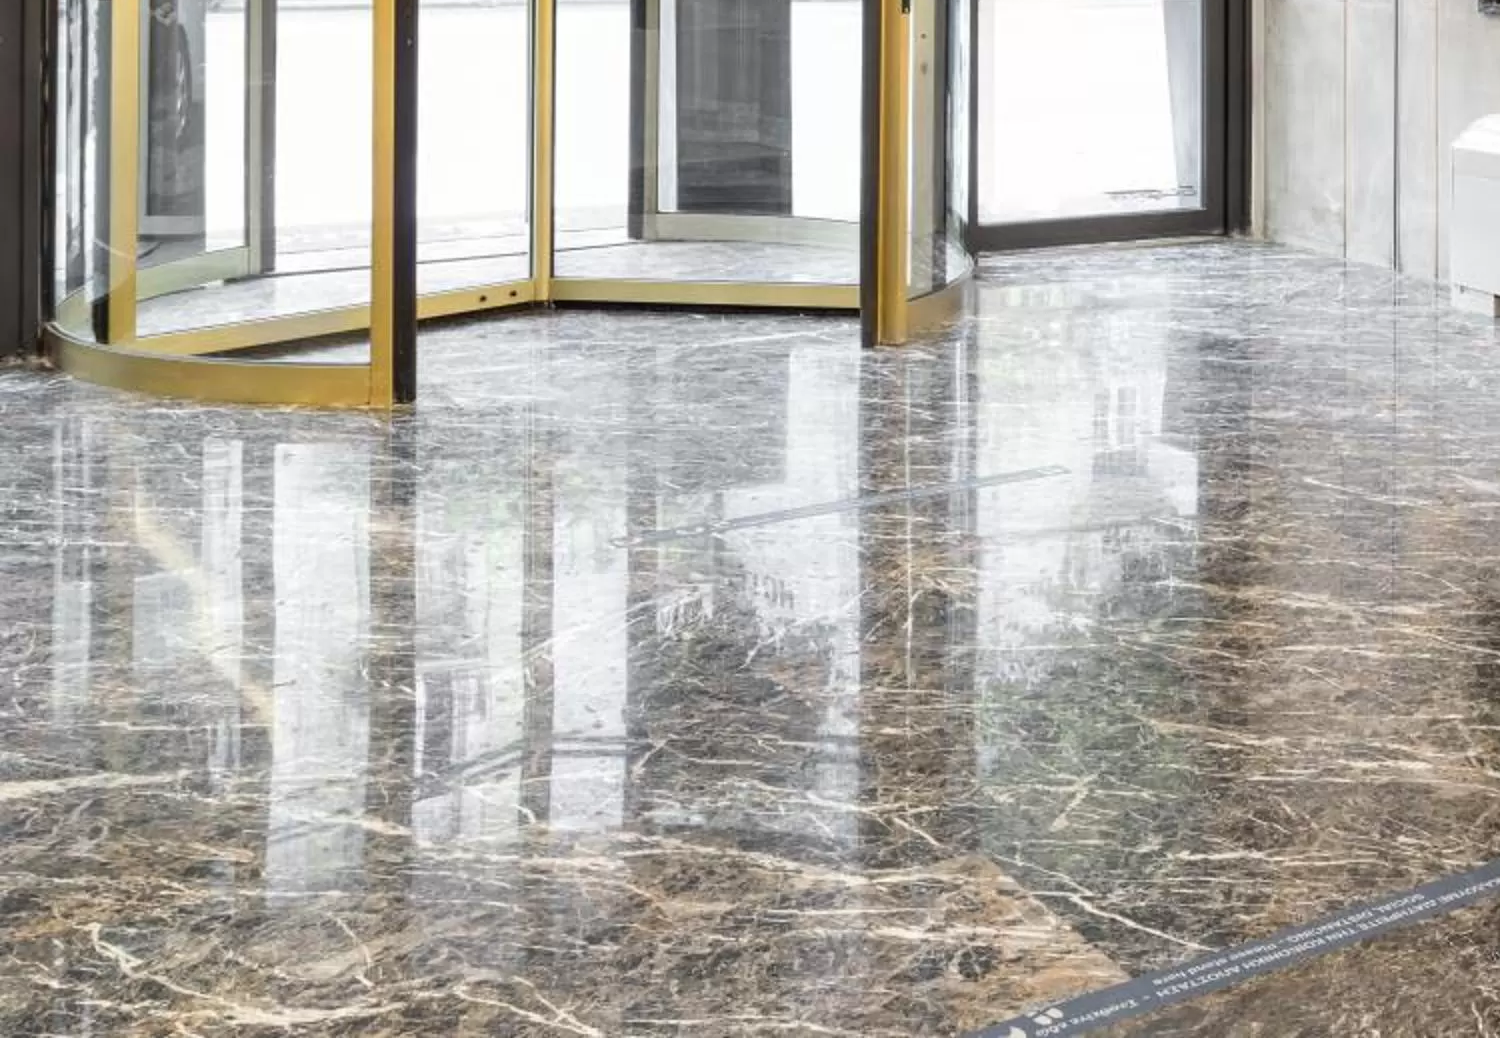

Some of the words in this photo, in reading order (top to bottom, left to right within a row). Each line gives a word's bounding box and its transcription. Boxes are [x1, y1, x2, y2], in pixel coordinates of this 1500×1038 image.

[1372, 892, 1426, 915] SOCIAL
[1285, 909, 1374, 944] DISTANCING
[1325, 926, 1356, 943] ΤΗΝ
[1156, 965, 1240, 999] ΑΠΟΣΤΑΣΗ
